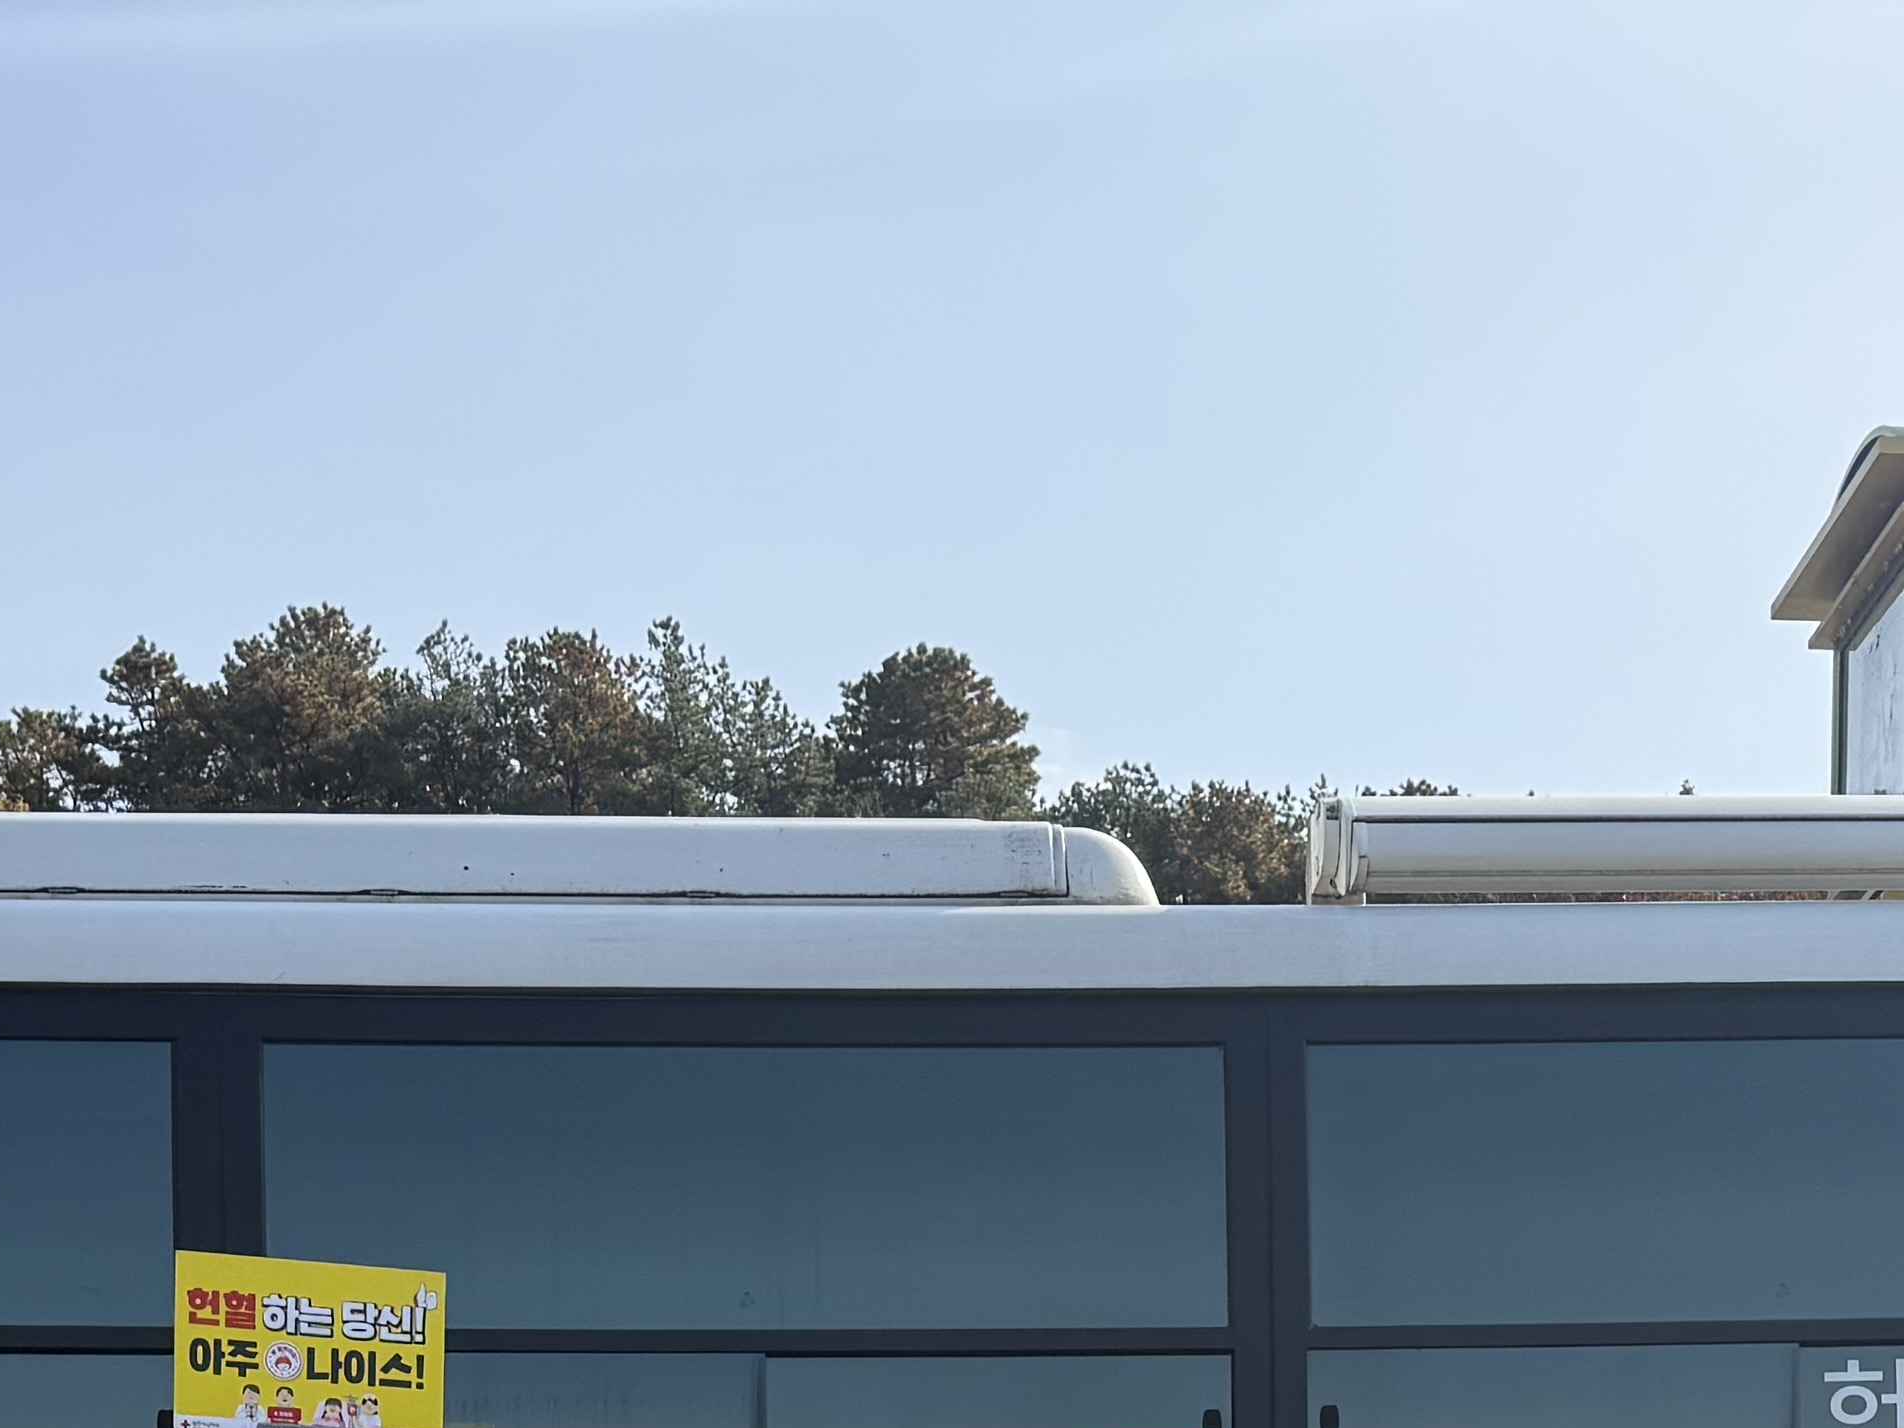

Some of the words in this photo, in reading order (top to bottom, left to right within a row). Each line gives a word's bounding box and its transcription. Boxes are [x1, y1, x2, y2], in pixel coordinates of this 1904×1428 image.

[341, 1300, 427, 1346] 당신!
[189, 1337, 260, 1378] 아주
[306, 1346, 425, 1390] 나이스!
